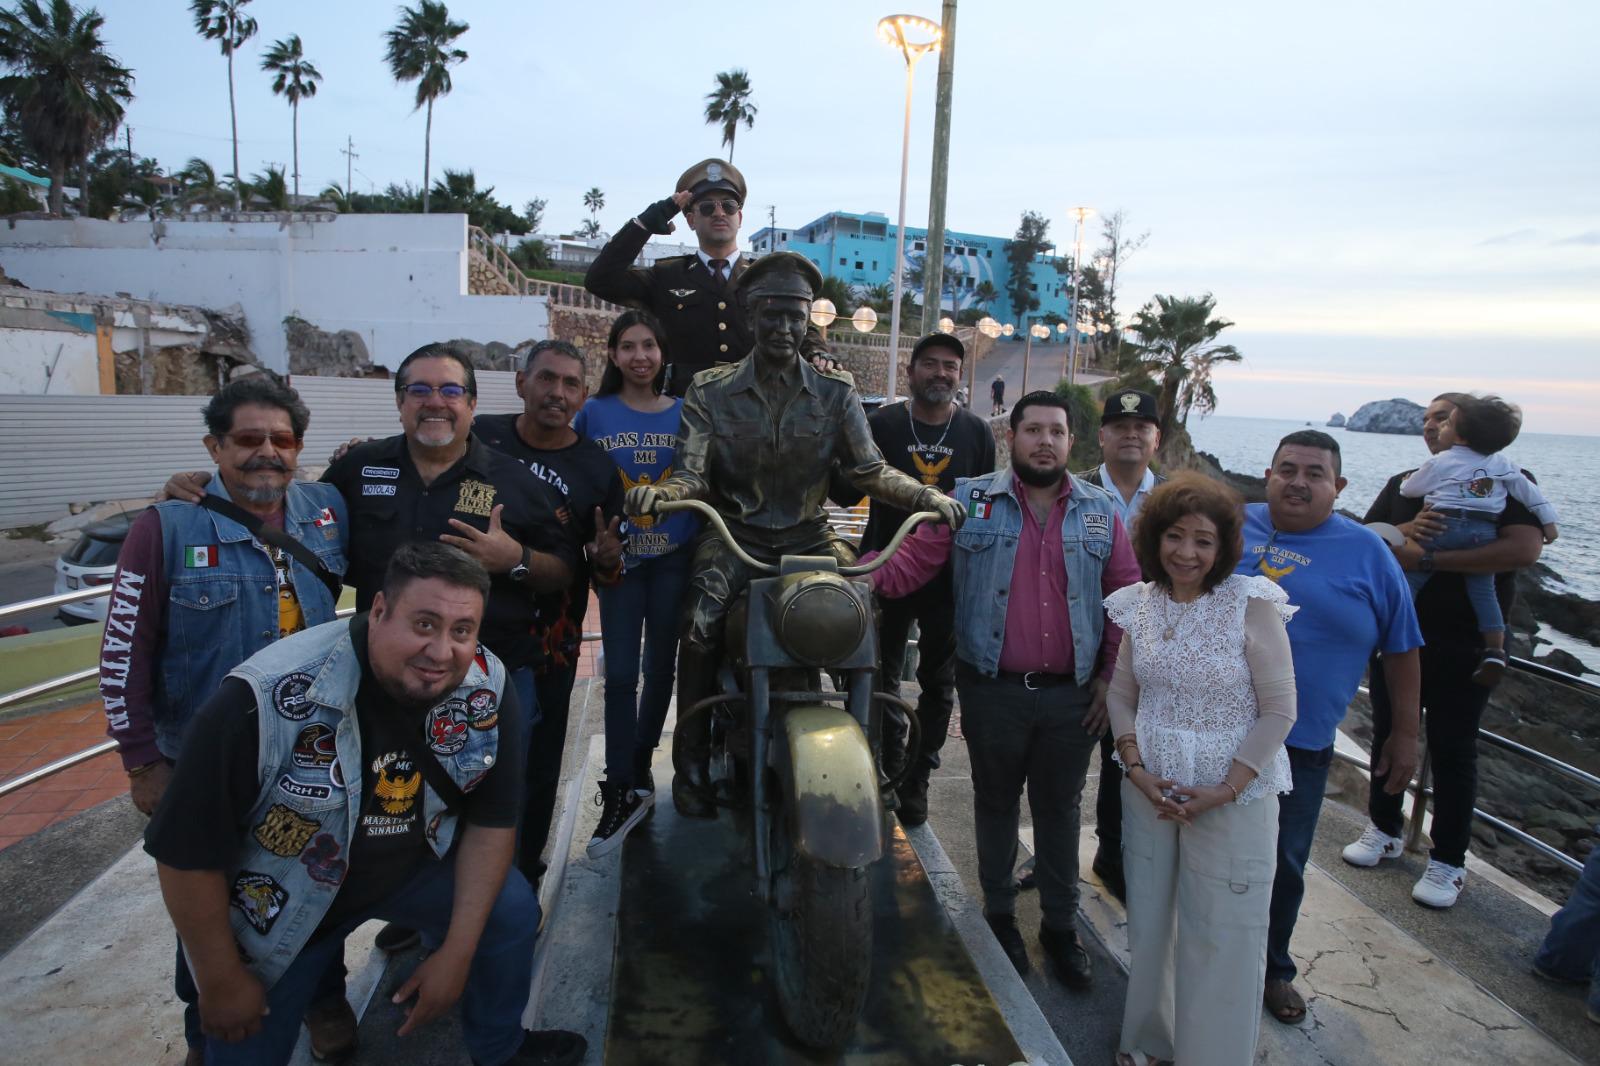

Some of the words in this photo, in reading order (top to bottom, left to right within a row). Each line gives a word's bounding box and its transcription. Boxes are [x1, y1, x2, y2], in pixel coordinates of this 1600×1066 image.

[641, 433, 677, 449] ALT
[634, 450, 657, 464] MC
[529, 462, 569, 496] ALTAS
[363, 485, 395, 494] MOTOLAS
[459, 486, 495, 502] OLAS
[972, 490, 980, 499] B
[637, 530, 669, 546] AÑOS
[372, 751, 398, 774] OLAS
[395, 761, 412, 770] MC
[367, 824, 409, 836] SINALOA
